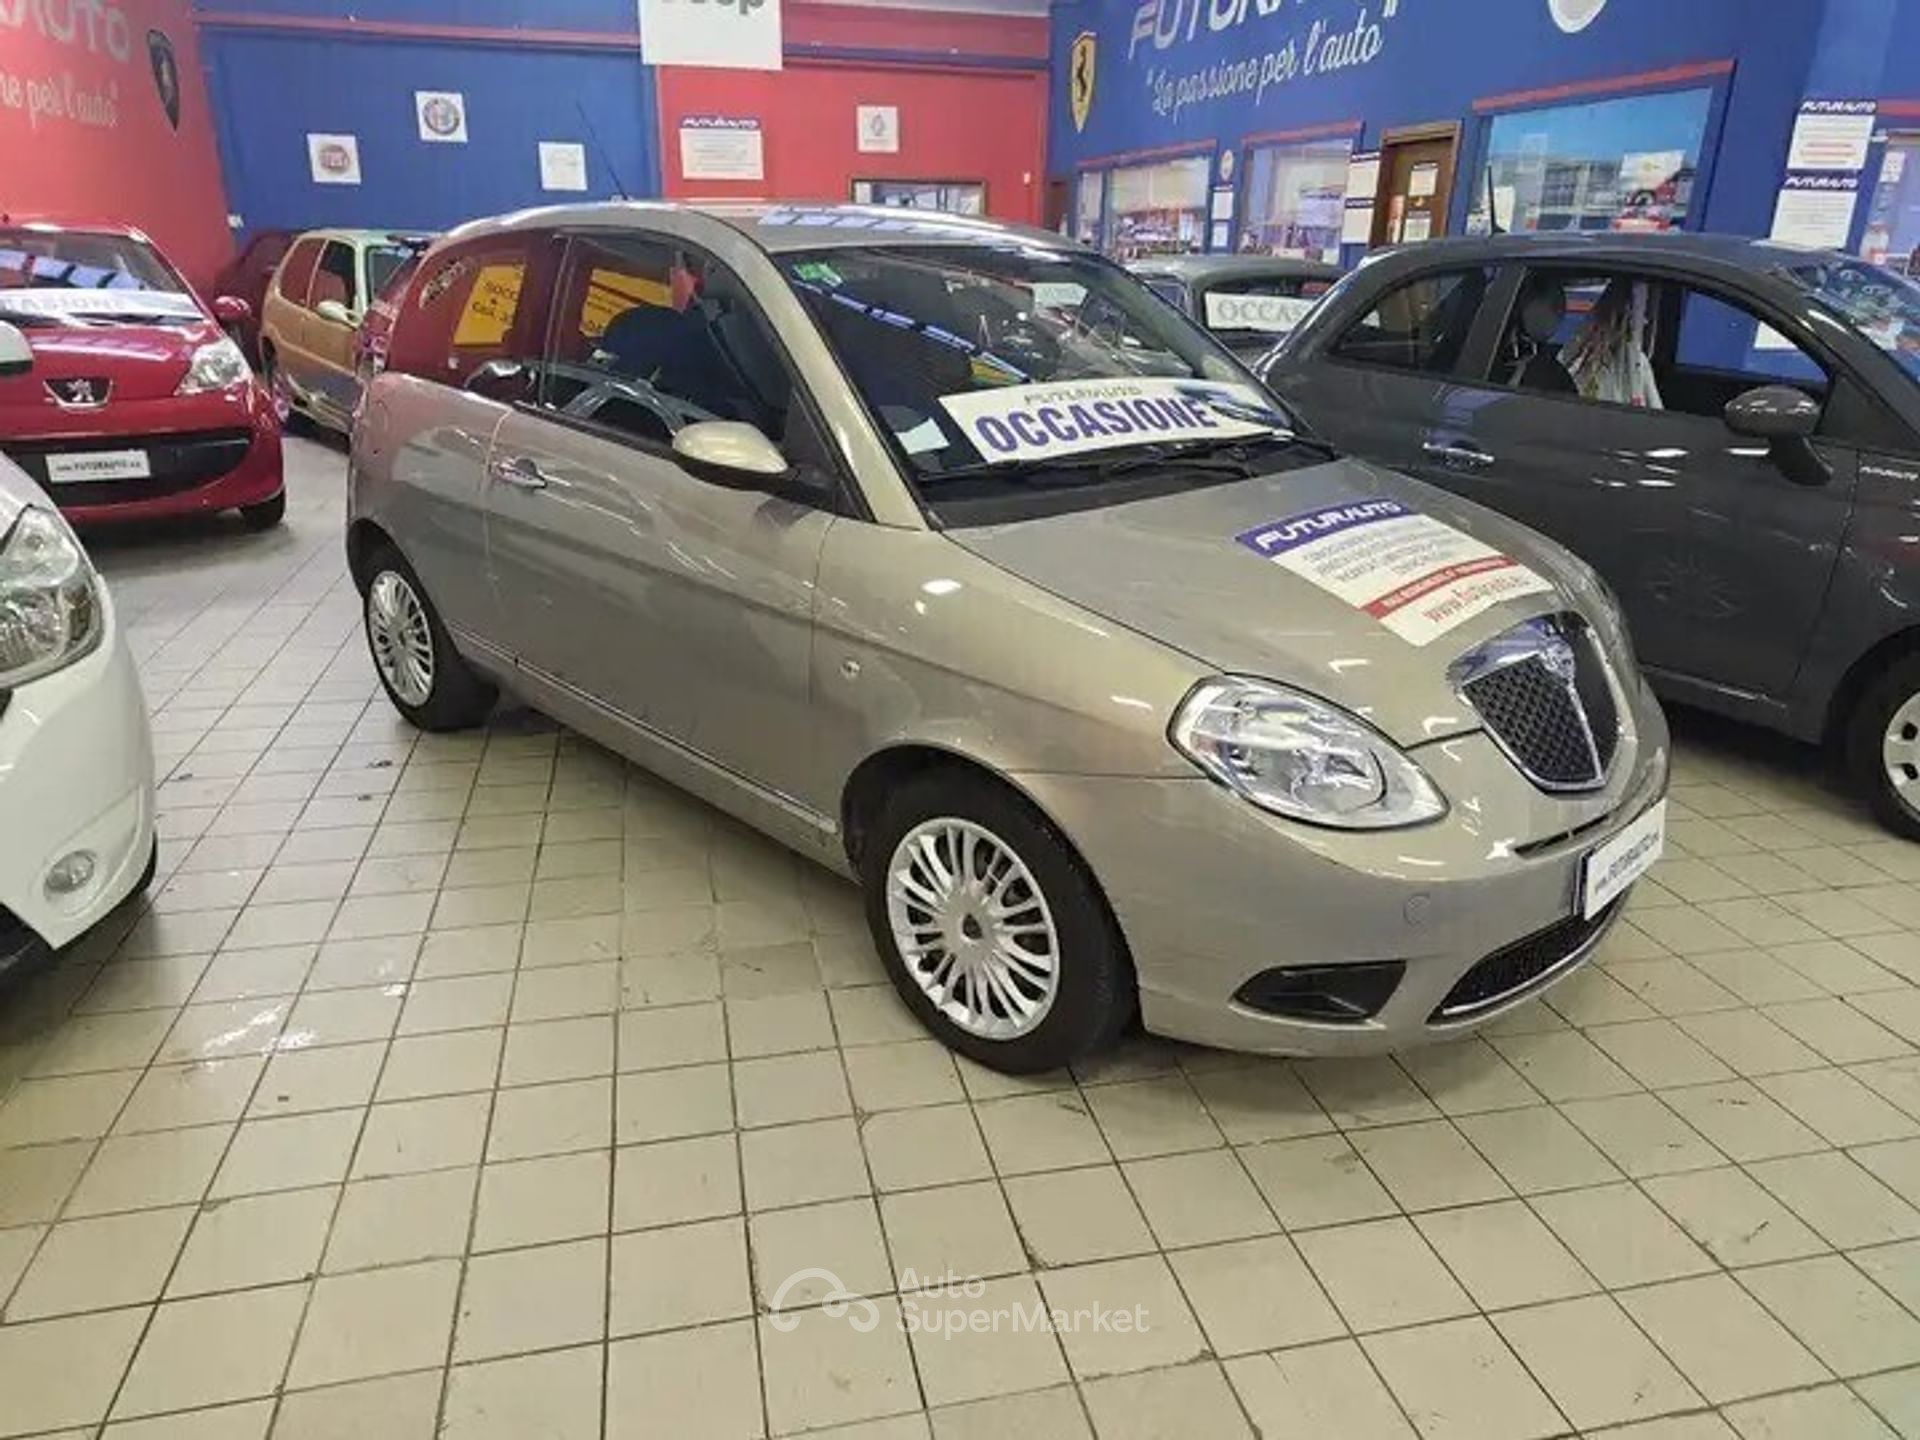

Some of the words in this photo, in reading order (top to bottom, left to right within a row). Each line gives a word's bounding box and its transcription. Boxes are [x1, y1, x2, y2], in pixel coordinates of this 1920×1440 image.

[1173, 55, 1261, 125] passione
[1254, 37, 1300, 106] per
[974, 397, 1219, 452] OCCASIONE
[1254, 501, 1402, 551] FUTURAUTO
